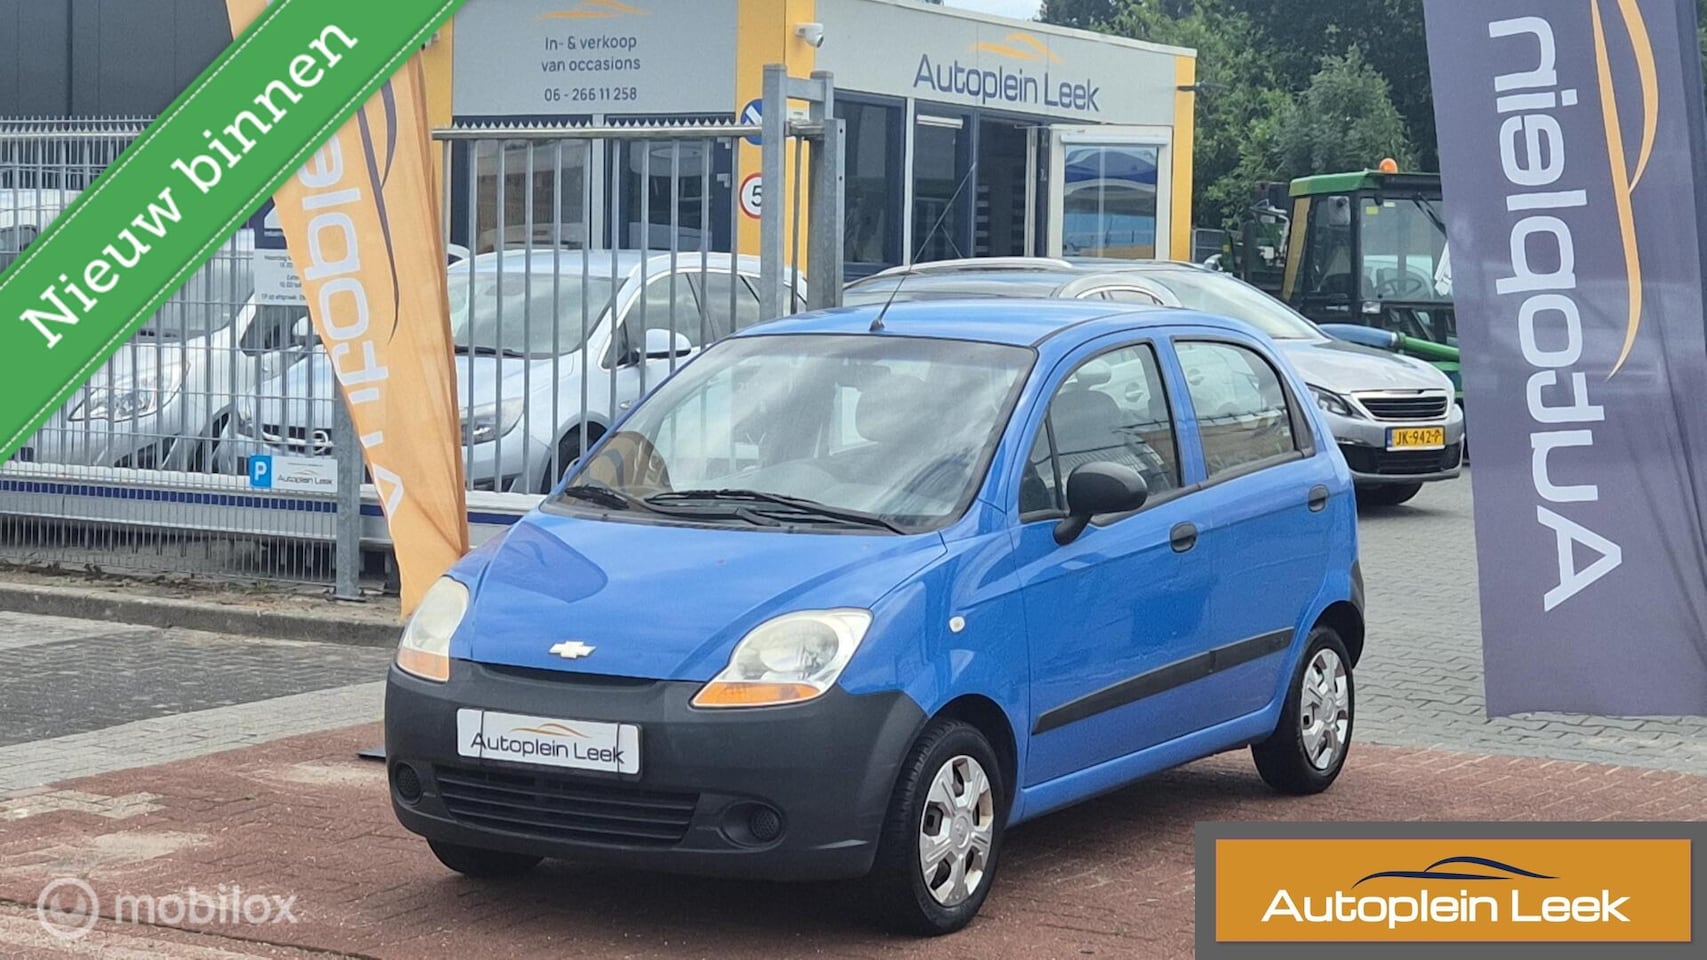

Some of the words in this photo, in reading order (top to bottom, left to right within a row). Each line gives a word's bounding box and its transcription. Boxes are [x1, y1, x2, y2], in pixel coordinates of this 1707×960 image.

[545, 36, 564, 51] In-
[567, 35, 577, 50] &
[580, 35, 638, 52] verkoop
[541, 60, 566, 73] van
[568, 56, 641, 72] occasions
[913, 53, 1038, 105] Autoplein
[1044, 72, 1100, 112] Leek
[544, 88, 561, 102] 06
[572, 87, 596, 101] 266
[613, 86, 638, 101] 258
[254, 461, 267, 480] P
[470, 732, 569, 758] Autoplein
[573, 742, 625, 765] Leek
